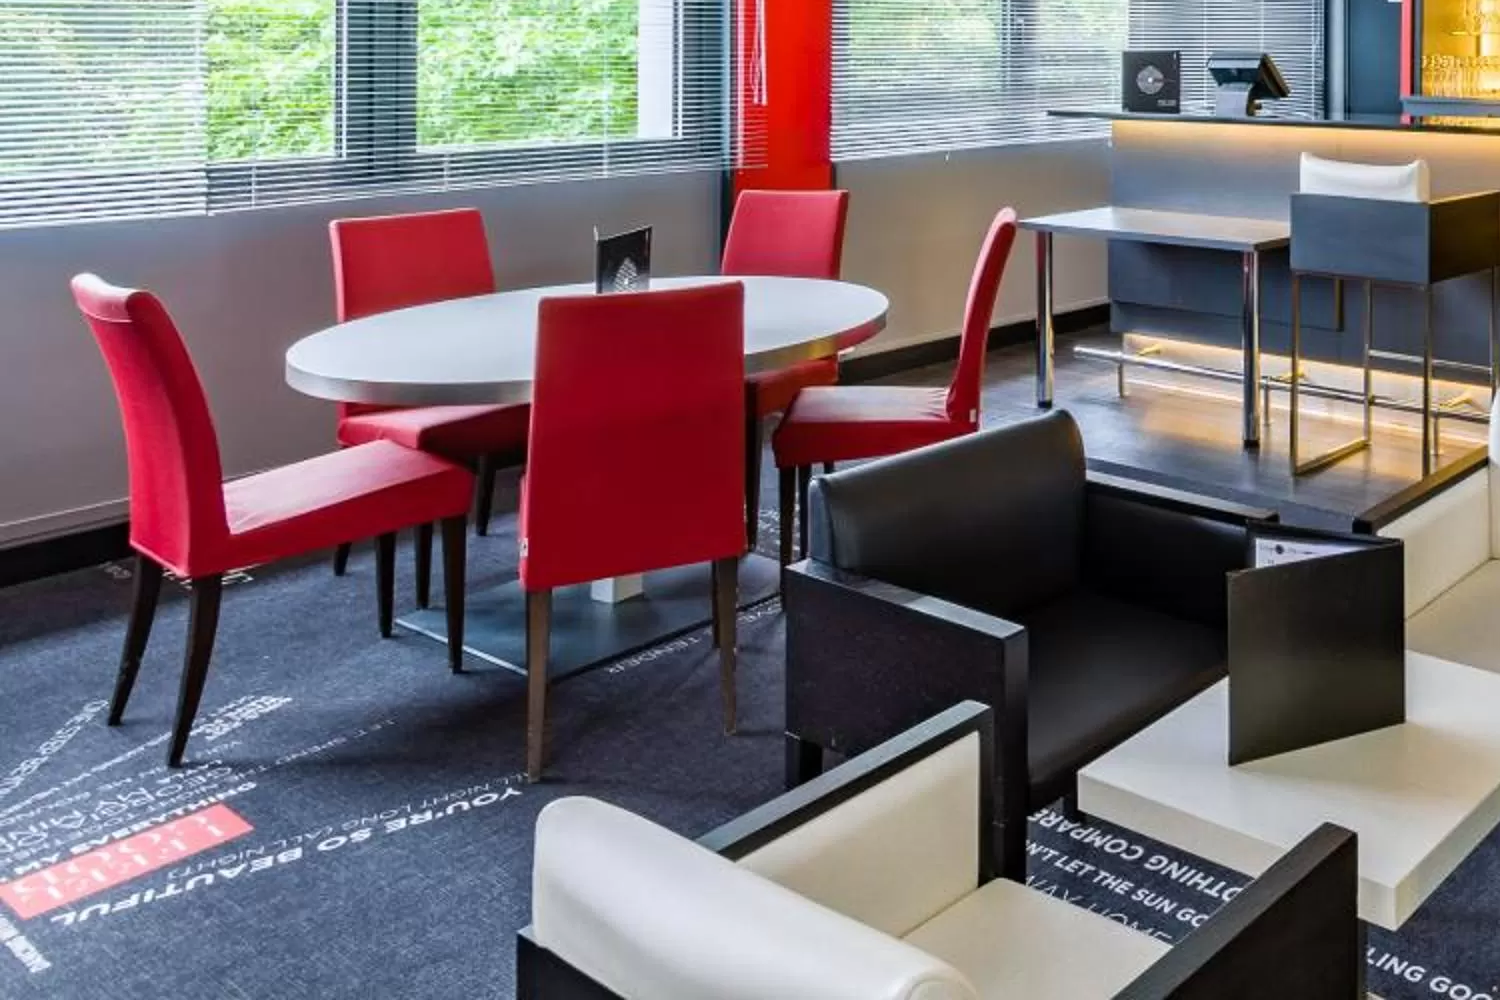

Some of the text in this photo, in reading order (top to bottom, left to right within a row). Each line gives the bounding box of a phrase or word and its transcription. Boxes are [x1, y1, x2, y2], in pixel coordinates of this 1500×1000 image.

[51, 787, 523, 925] YOU'RE SO BEAUTIFUL
[1054, 855, 1097, 877] LET
[1093, 870, 1135, 895] THE
[1131, 888, 1177, 914] SUN
